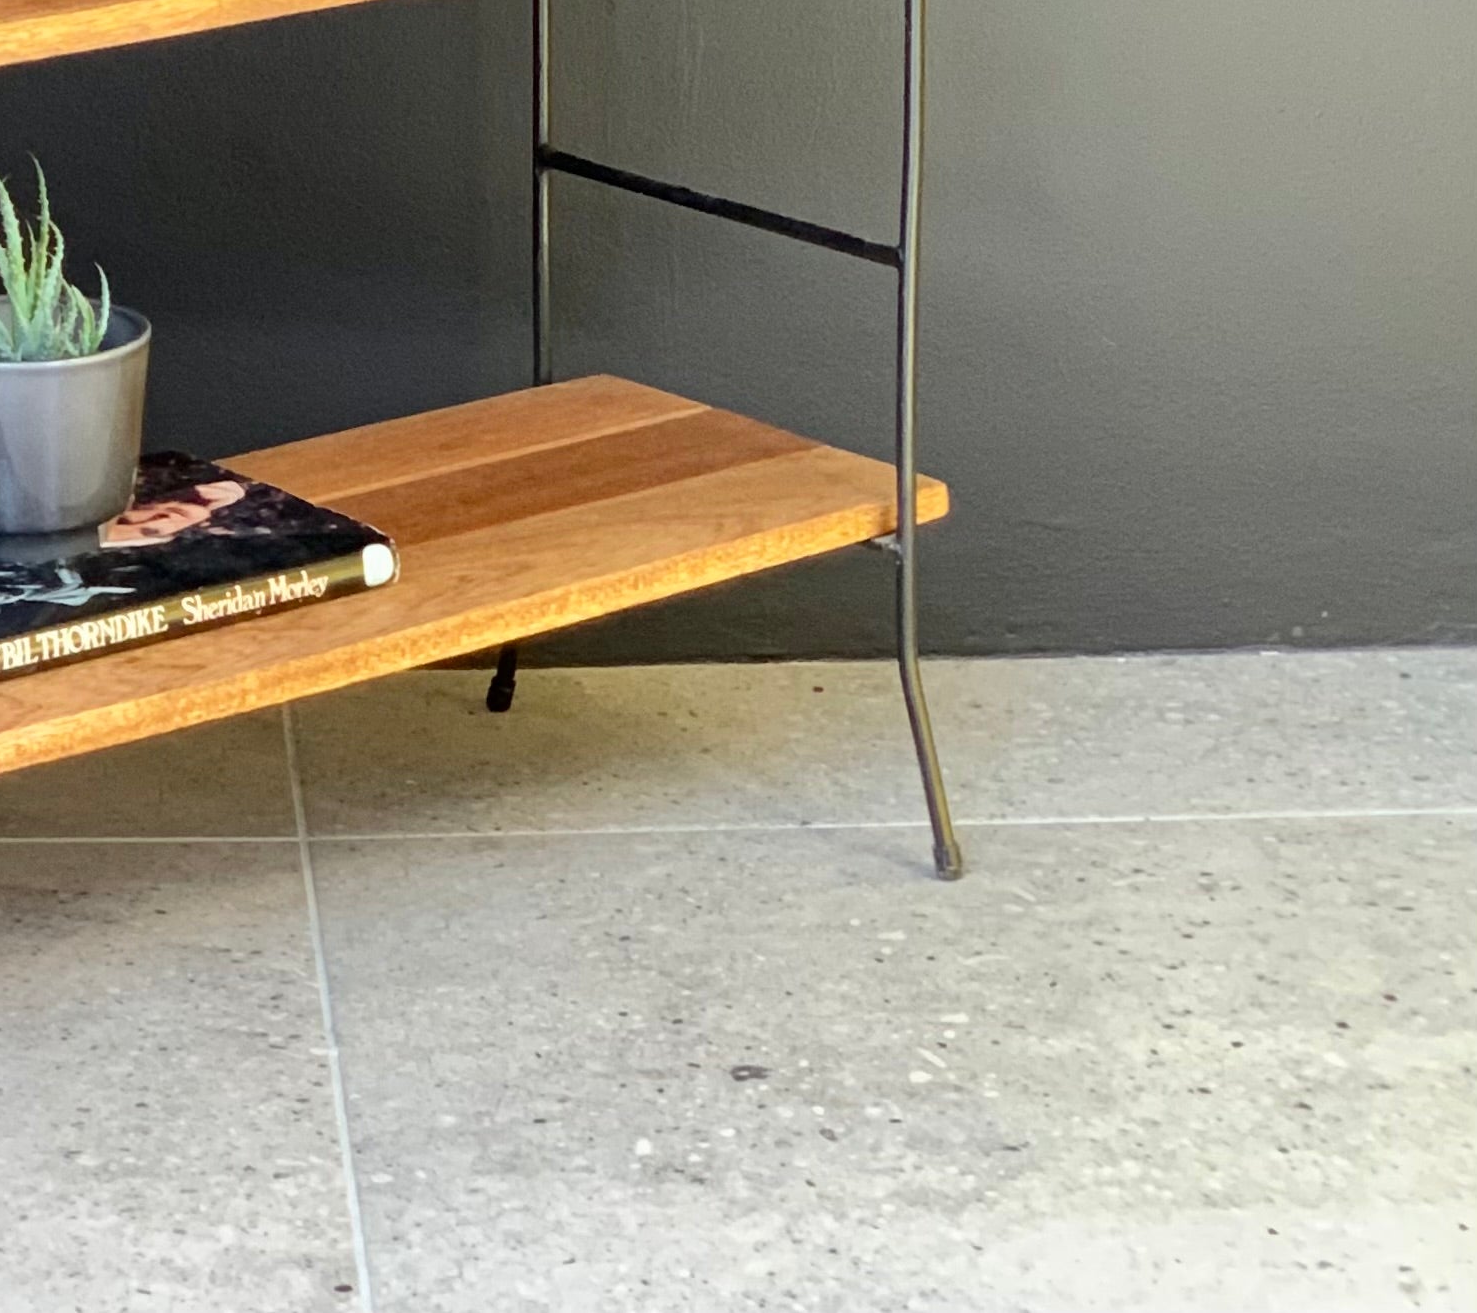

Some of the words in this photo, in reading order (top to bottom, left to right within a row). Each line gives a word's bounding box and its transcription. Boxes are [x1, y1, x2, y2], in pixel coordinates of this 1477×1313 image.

[34, 606, 169, 661] THORNDIKE
[180, 586, 266, 626] Sheridan
[268, 569, 329, 606] Morley
